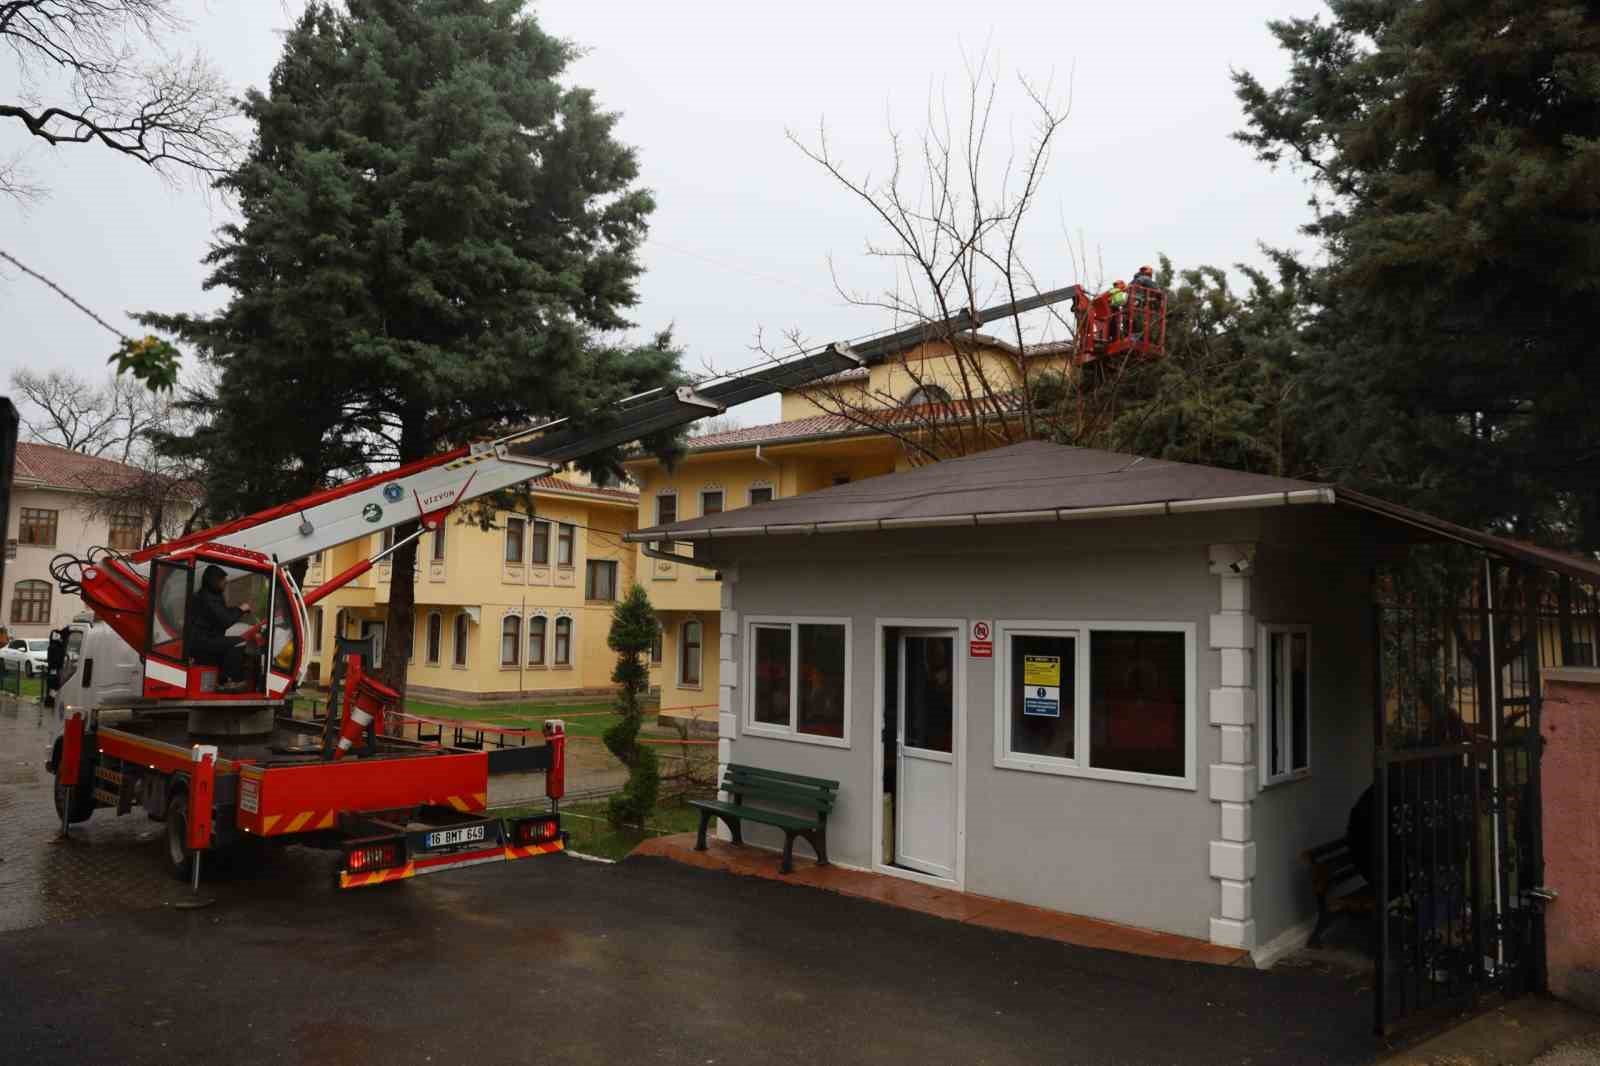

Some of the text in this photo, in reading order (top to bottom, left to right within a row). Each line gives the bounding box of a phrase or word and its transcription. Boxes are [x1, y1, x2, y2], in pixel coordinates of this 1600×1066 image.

[431, 827, 483, 845] 16 BMT 649
